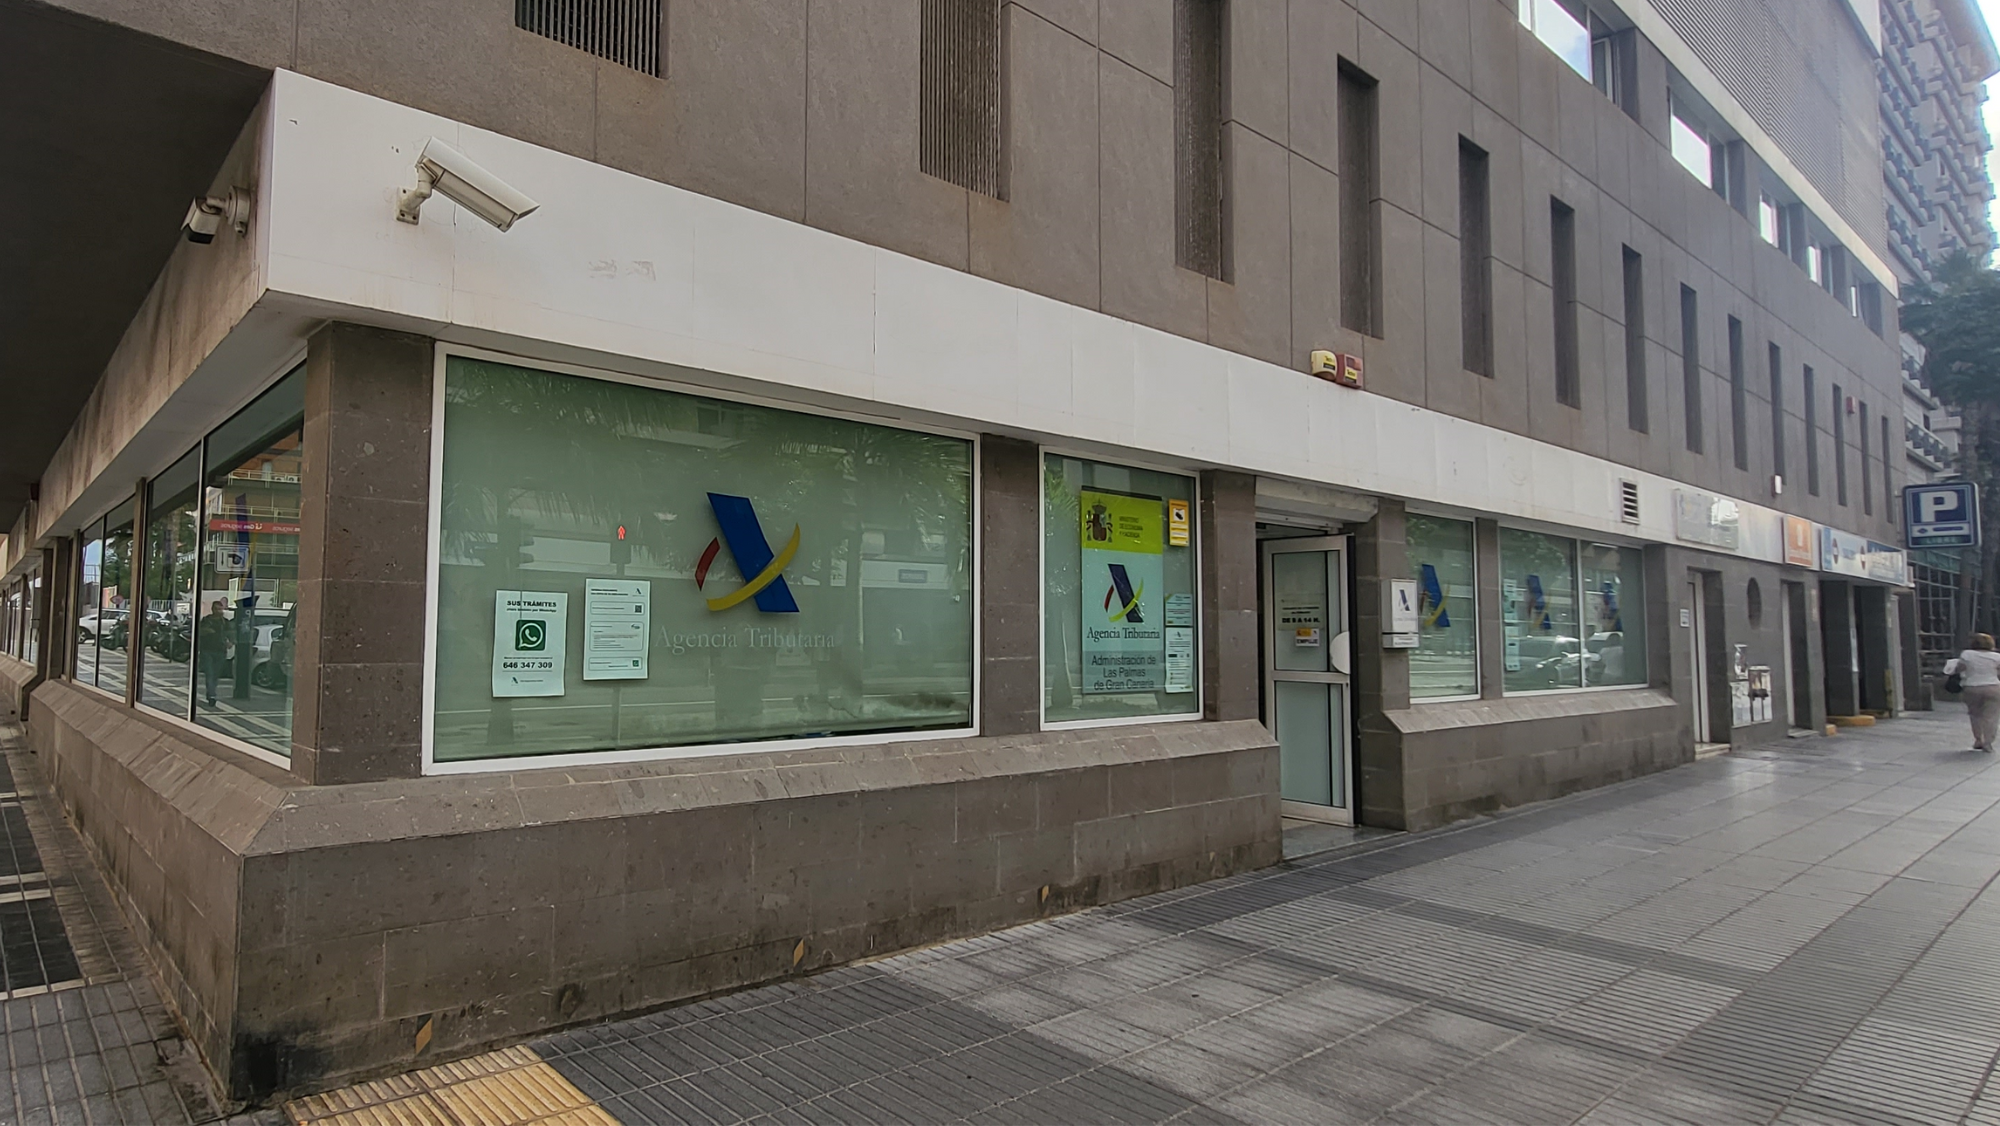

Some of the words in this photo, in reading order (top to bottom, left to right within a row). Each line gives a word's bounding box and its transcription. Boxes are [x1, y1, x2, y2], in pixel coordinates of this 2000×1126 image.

[1920, 491, 1958, 523] P
[522, 600, 557, 608] TRÁMITES
[655, 625, 737, 655] Agencia
[744, 625, 835, 648] Tributaria
[1087, 626, 1121, 643] Agencia
[1122, 626, 1160, 639] Tributaria
[503, 661, 518, 669] 646
[520, 661, 536, 669] 347
[537, 661, 553, 669] 309
[1091, 655, 1146, 666] Administración
[1147, 654, 1156, 665] de
[1103, 667, 1117, 678] Las
[1119, 667, 1146, 677] Palmas
[1093, 680, 1105, 691] de
[1105, 679, 1125, 690] Gran
[1126, 679, 1155, 689] Canaria
